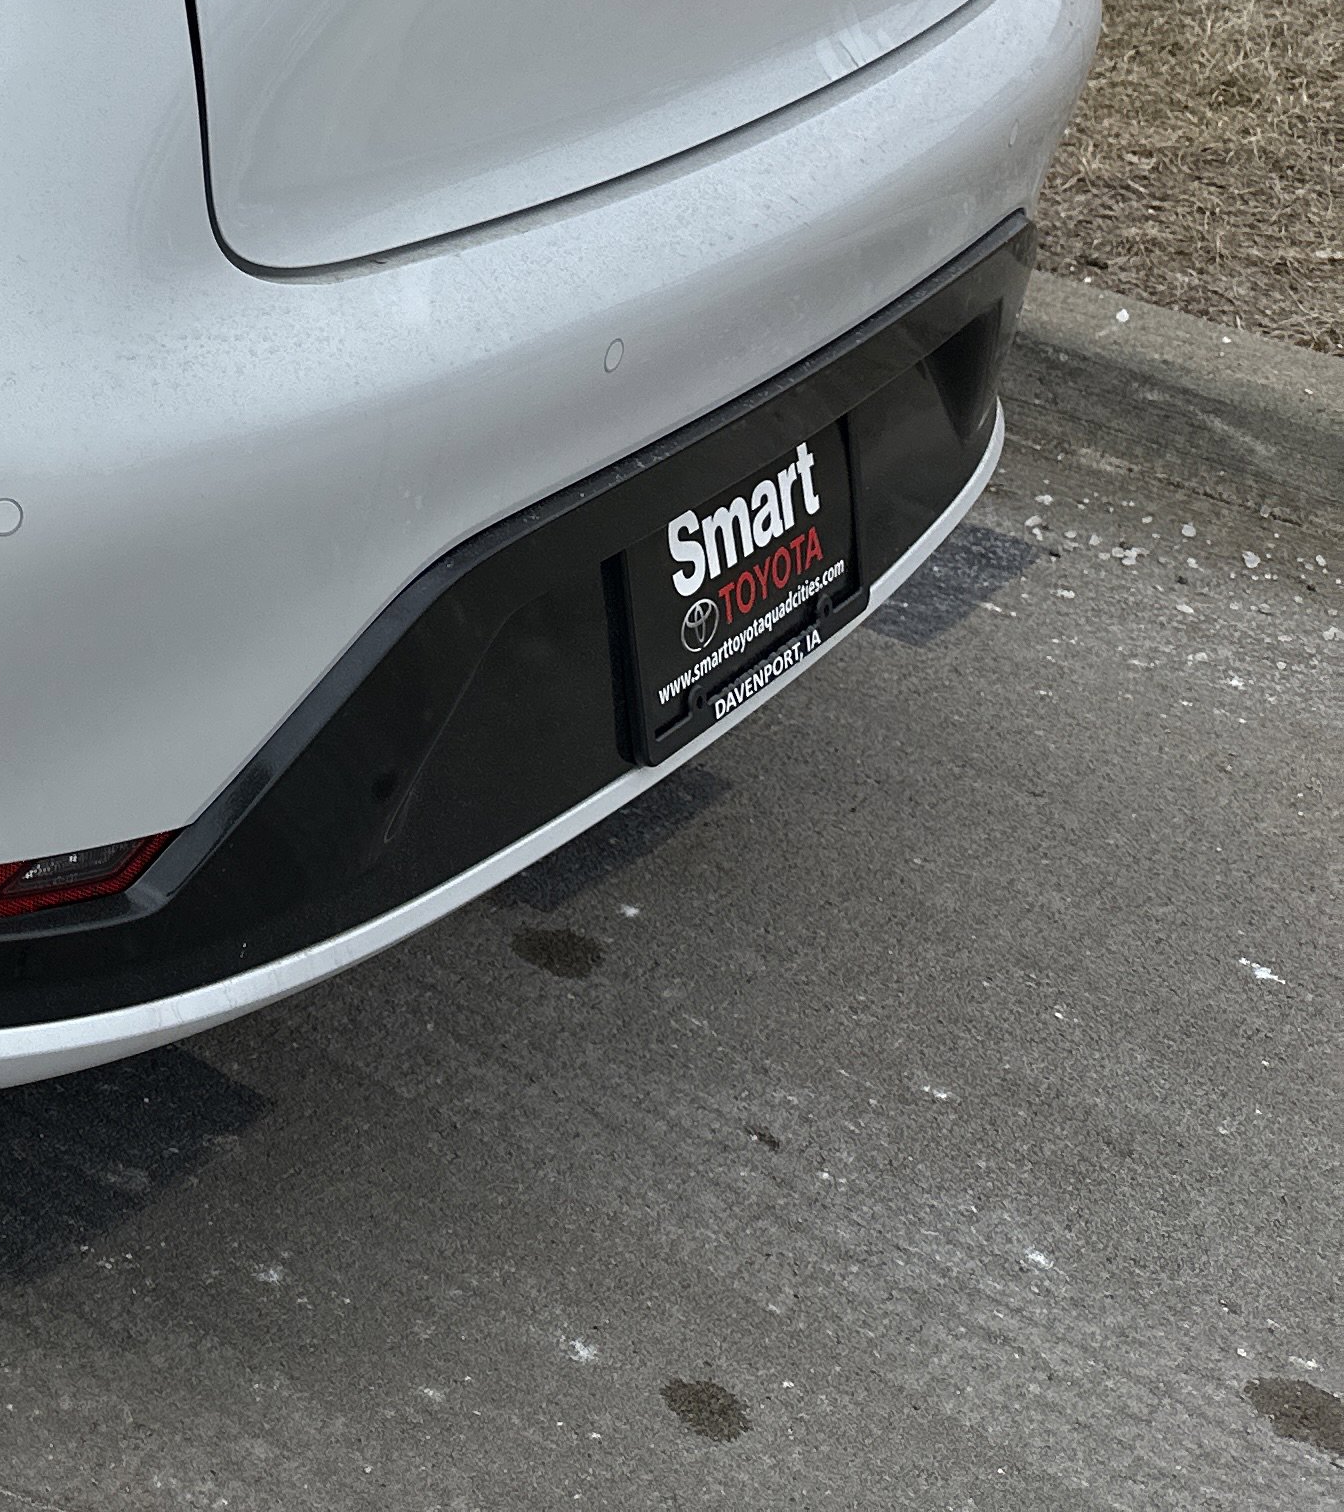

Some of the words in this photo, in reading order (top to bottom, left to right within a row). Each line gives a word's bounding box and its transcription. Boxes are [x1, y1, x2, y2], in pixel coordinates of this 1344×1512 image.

[667, 442, 821, 597] Smart
[718, 525, 824, 625] TOYOTA
[658, 558, 845, 705] www.smarttoyotaquadcities.com
[715, 641, 805, 720] DAVENPORT,
[806, 629, 822, 653] IA
